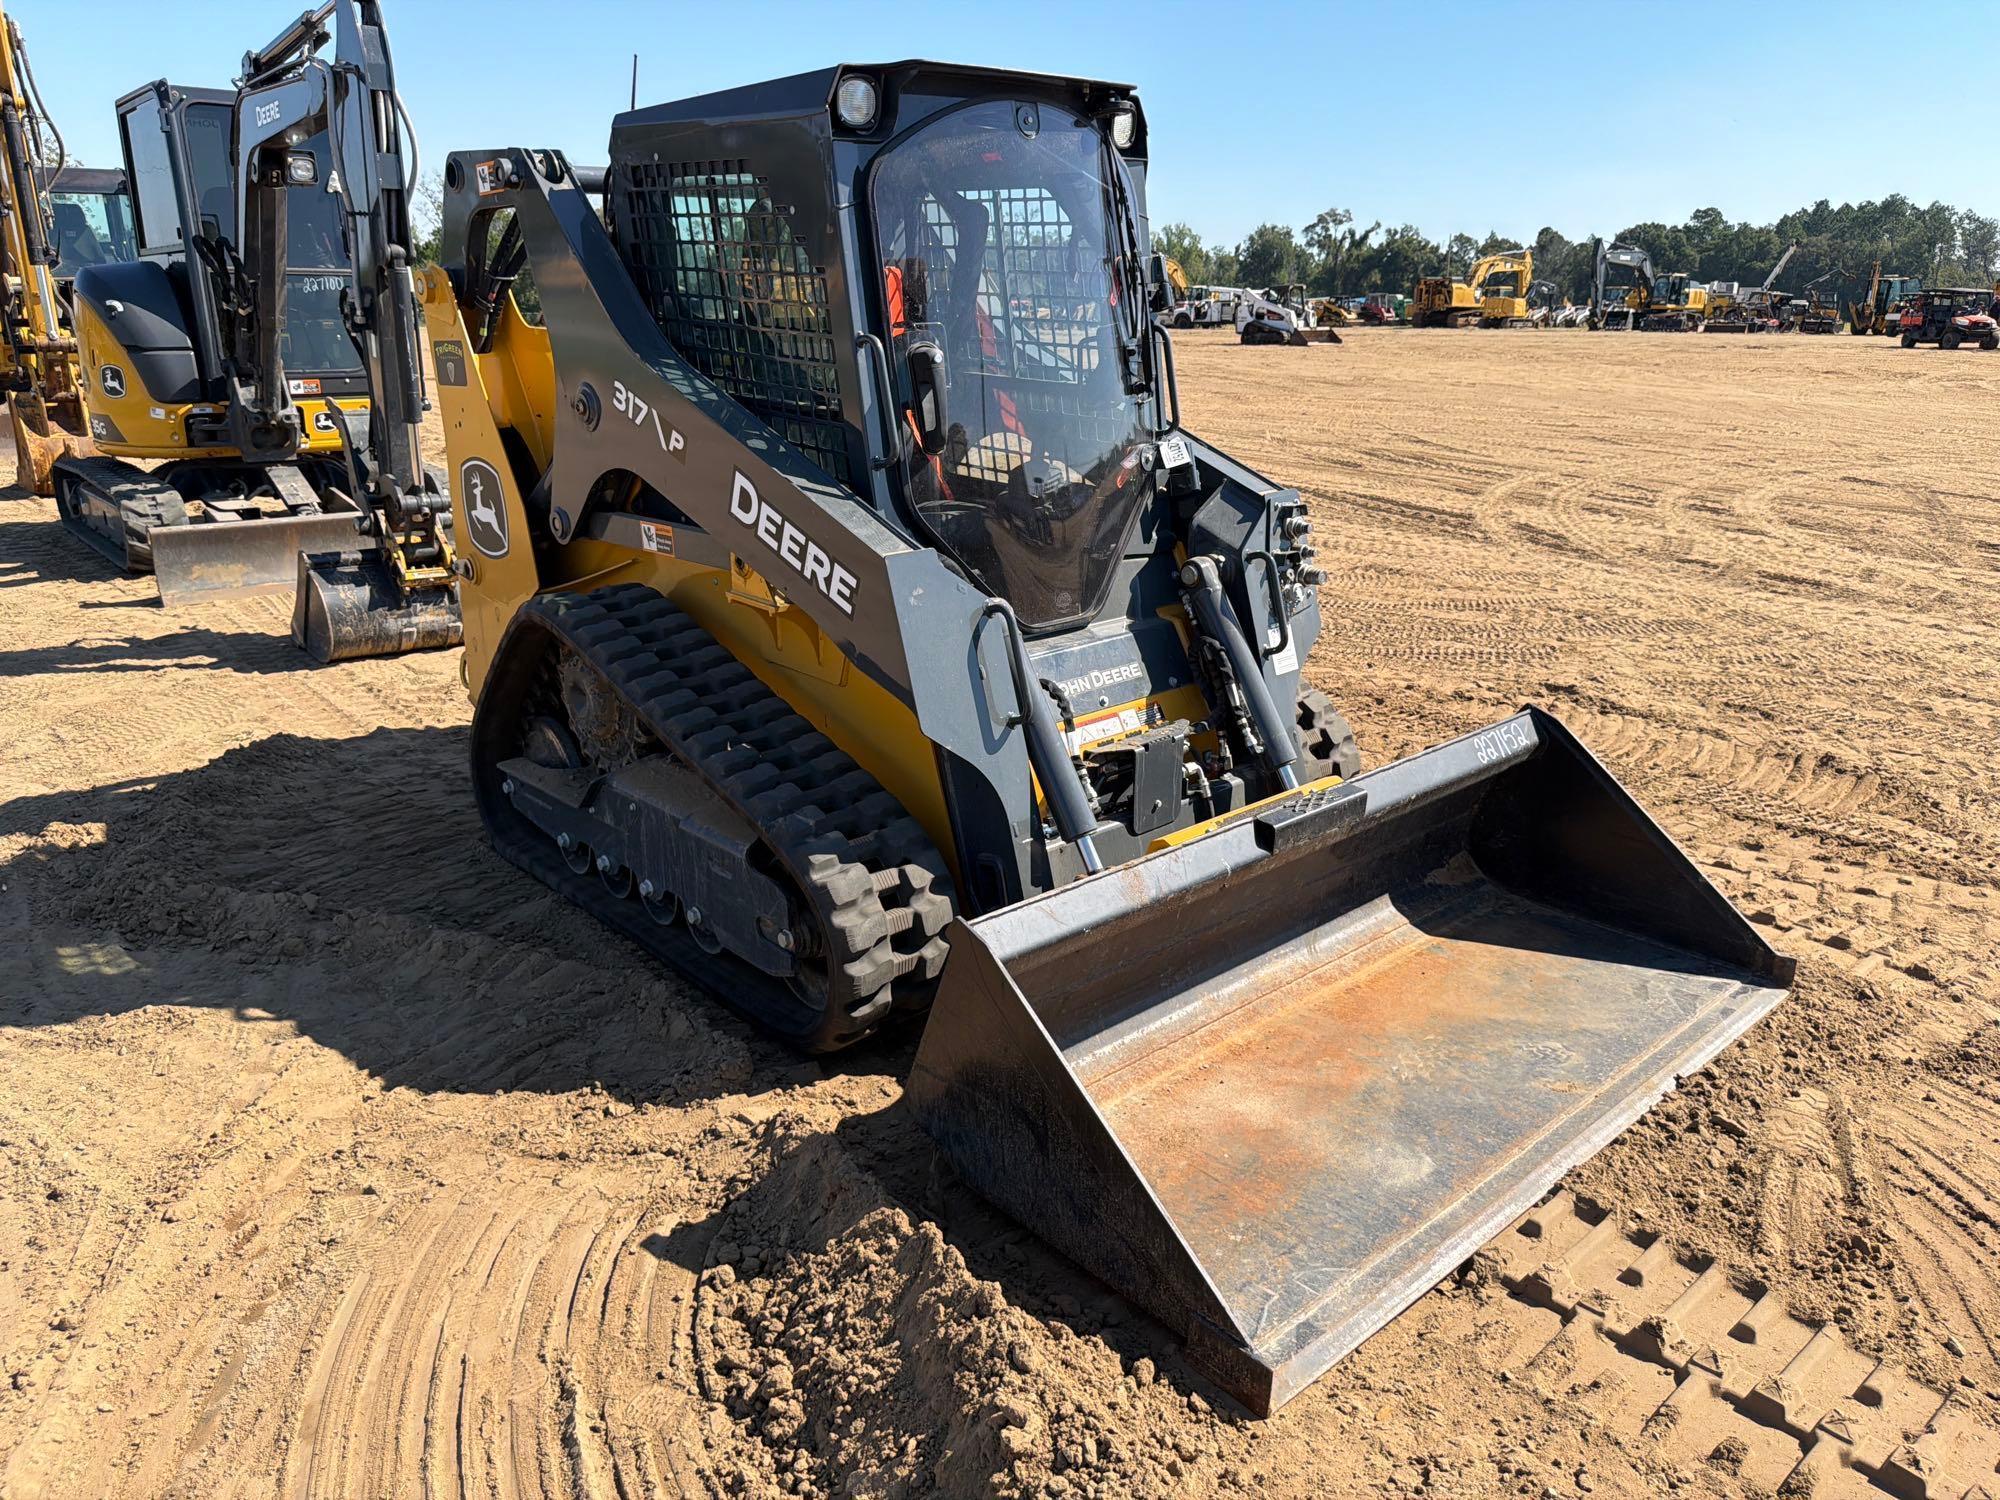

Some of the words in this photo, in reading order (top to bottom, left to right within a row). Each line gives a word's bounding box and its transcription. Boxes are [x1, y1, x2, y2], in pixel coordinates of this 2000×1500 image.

[255, 100, 281, 127] DEERE
[303, 276, 344, 294] 227100
[612, 380, 649, 426] 317
[730, 470, 858, 615] DEERE
[1059, 675, 1092, 697] OHN
[1091, 662, 1143, 689] DEERE
[1473, 722, 1530, 764] 227152
